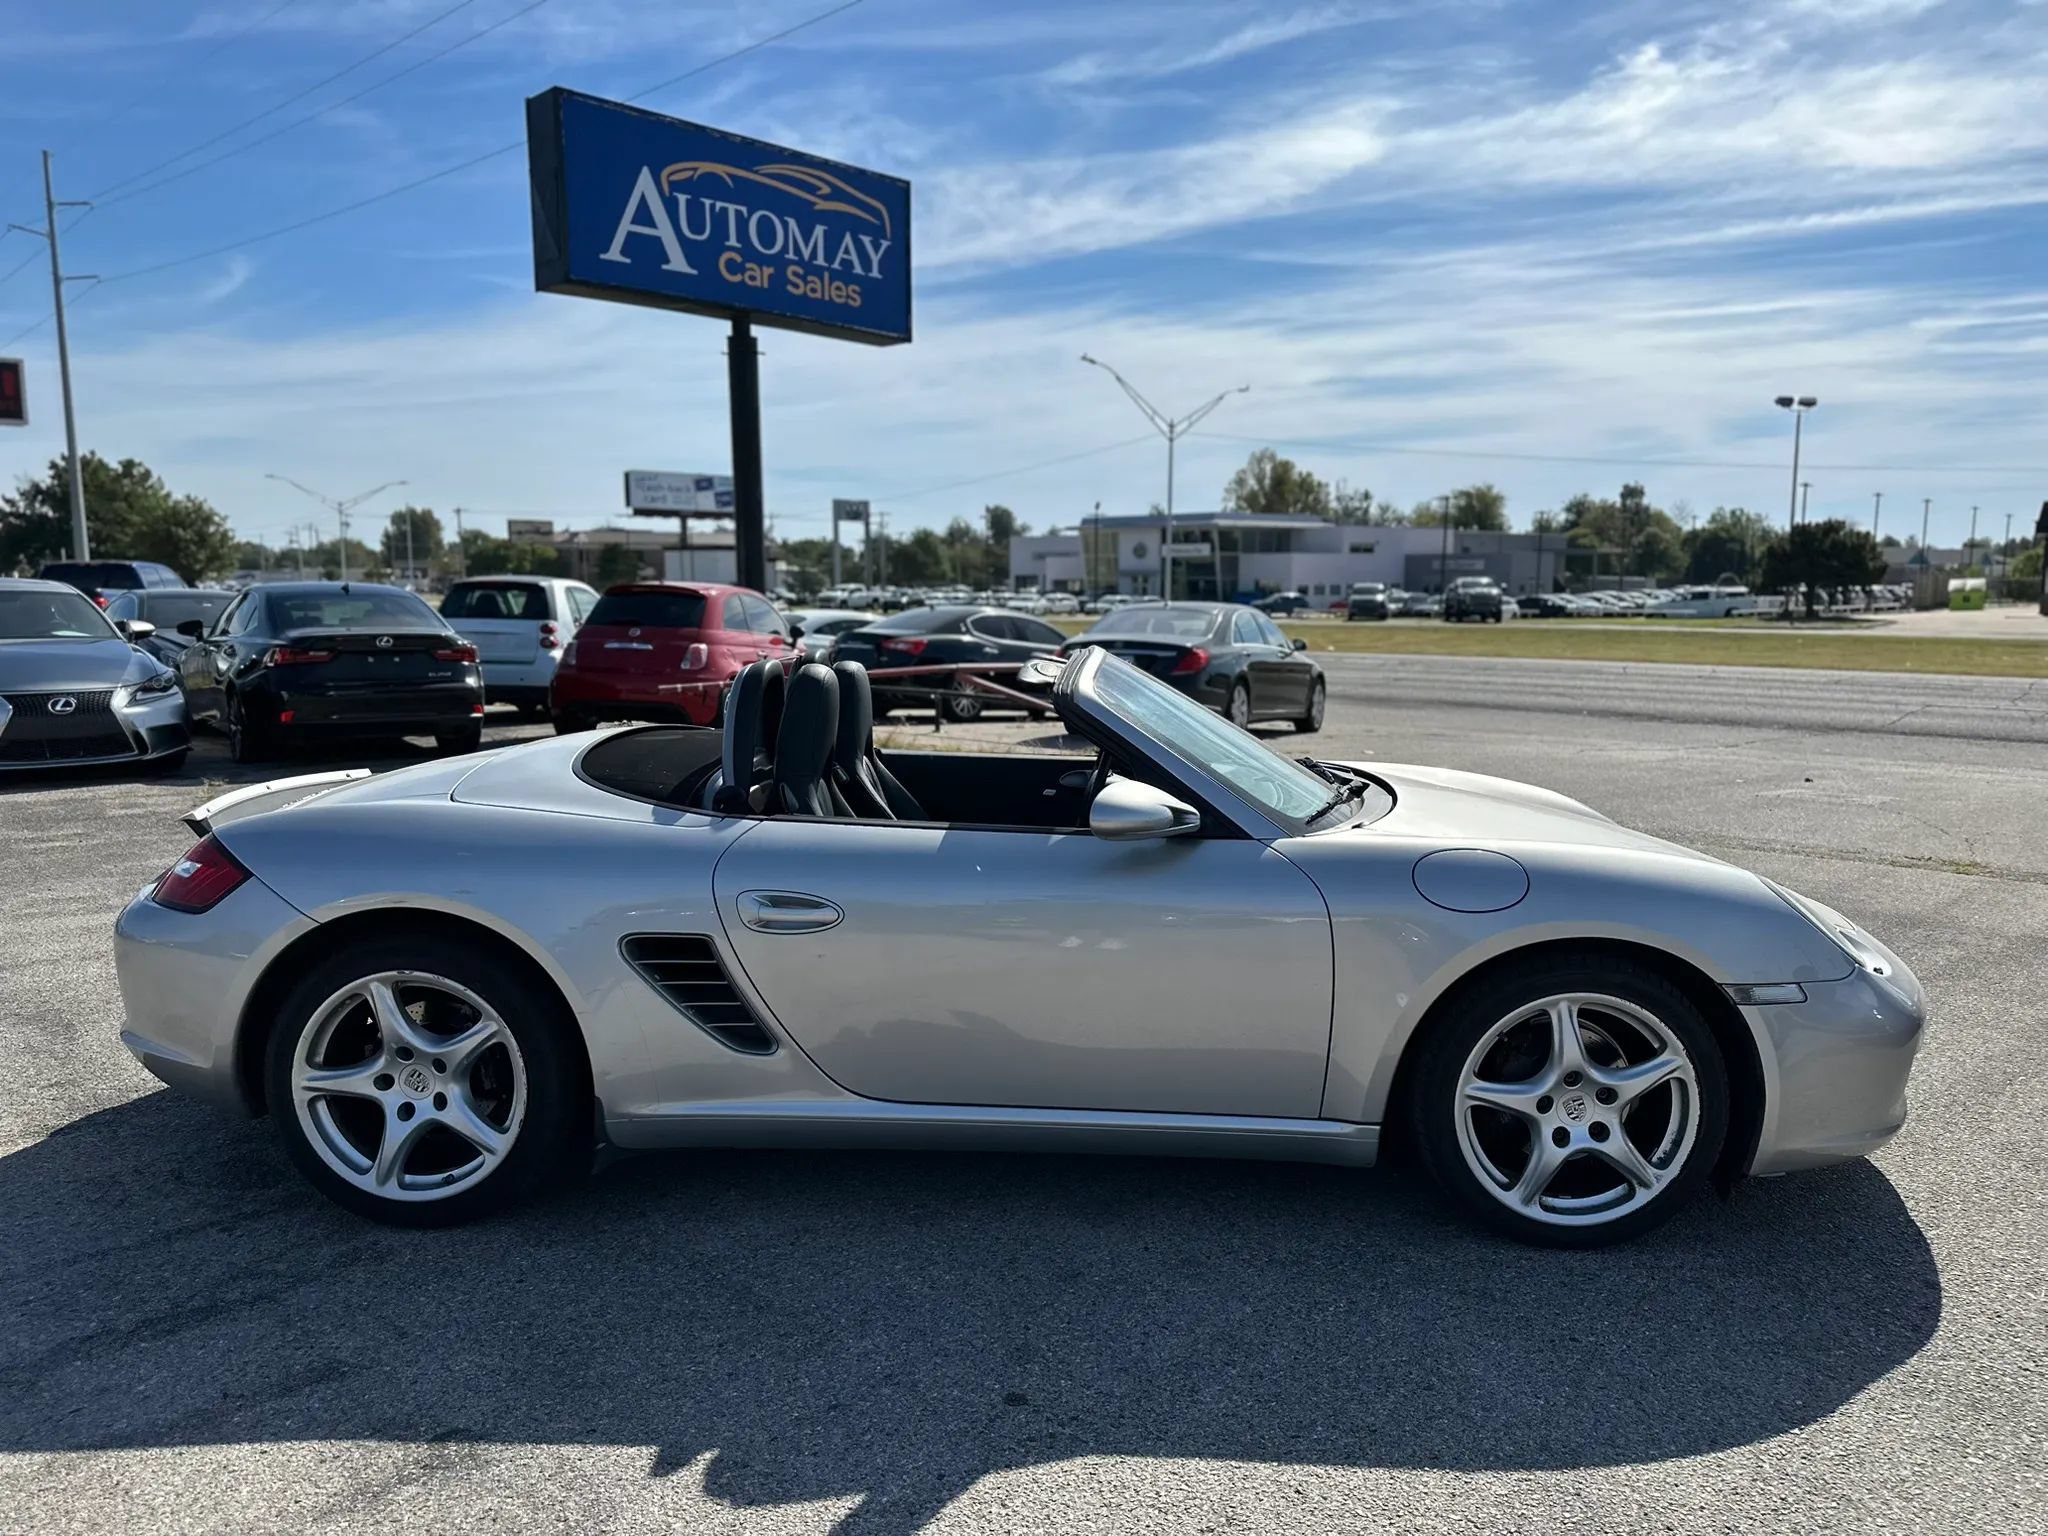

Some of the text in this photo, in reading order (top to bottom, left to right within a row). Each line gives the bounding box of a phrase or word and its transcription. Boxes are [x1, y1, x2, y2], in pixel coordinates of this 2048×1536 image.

[600, 166, 892, 279] AUTOMAY
[718, 251, 862, 308] Car Sales
